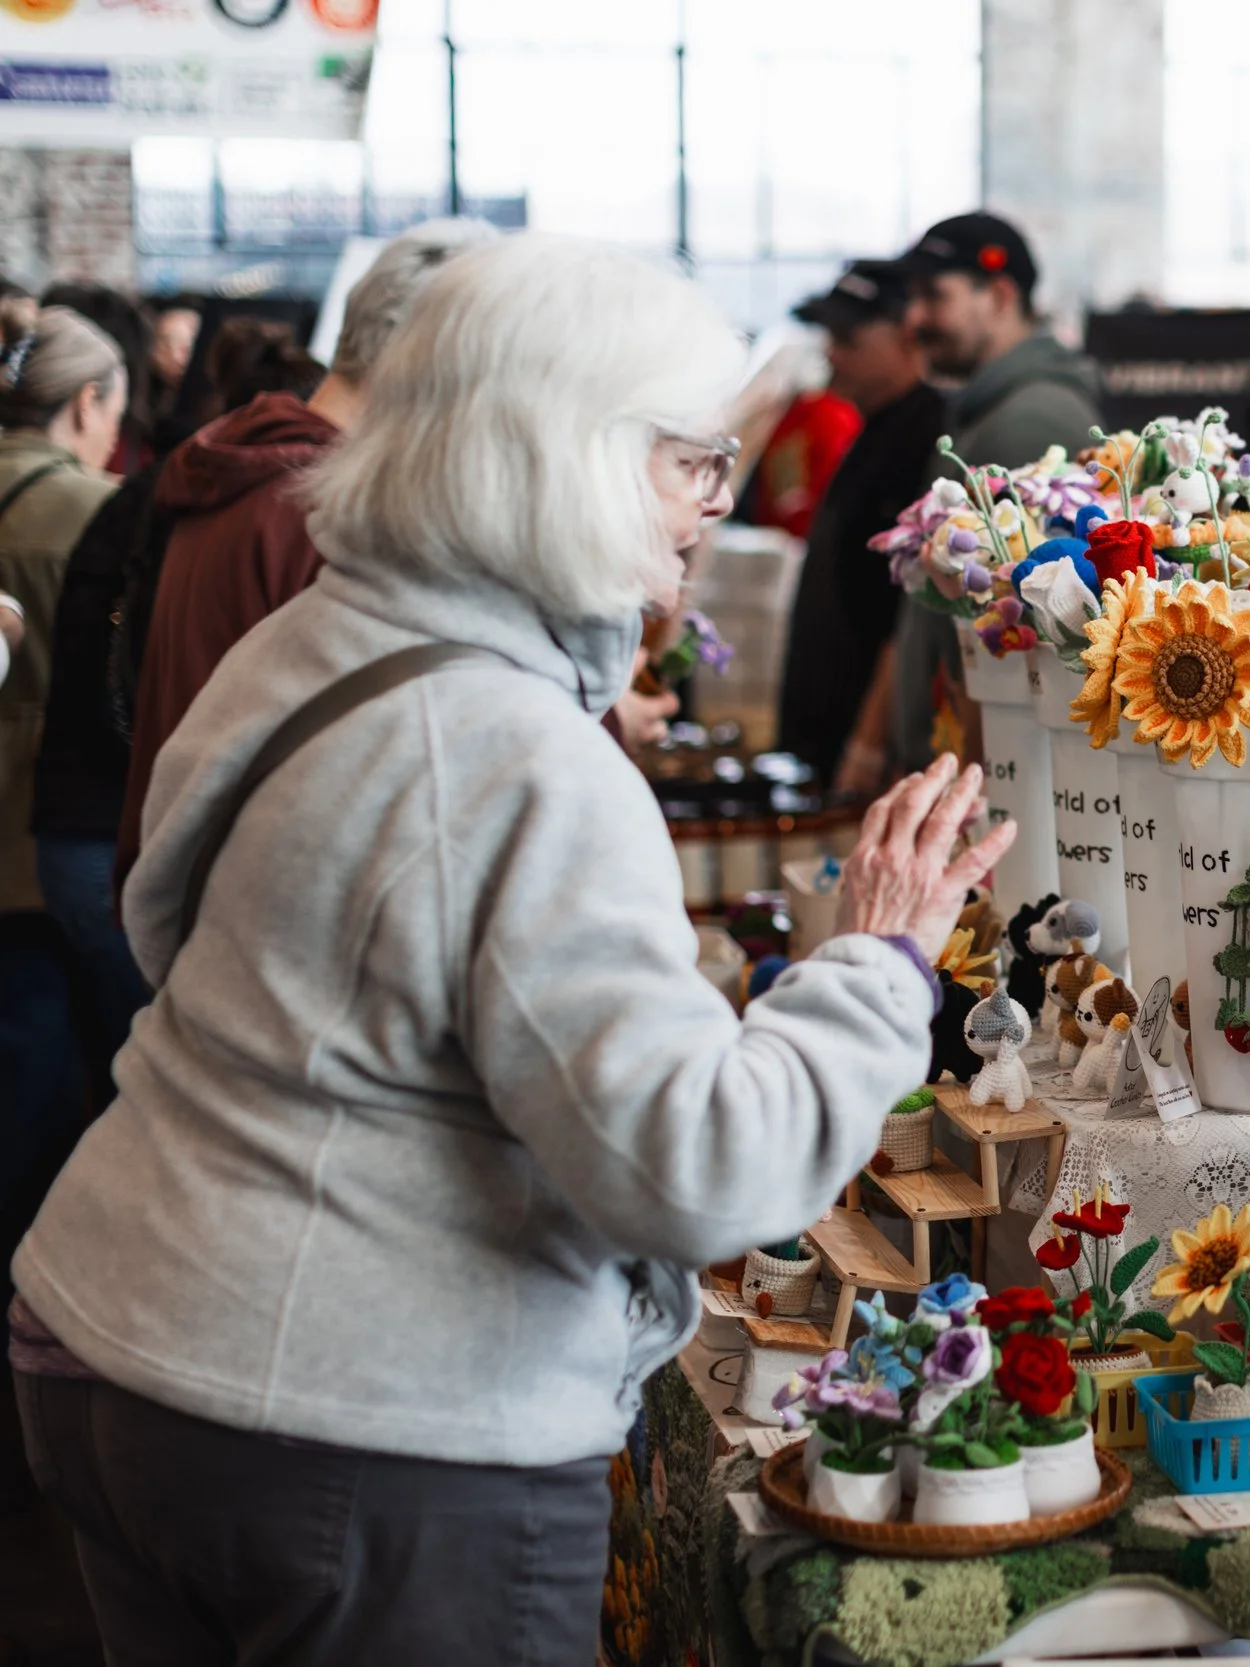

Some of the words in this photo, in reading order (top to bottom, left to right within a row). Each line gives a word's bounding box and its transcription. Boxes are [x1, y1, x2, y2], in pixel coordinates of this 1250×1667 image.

[995, 761, 1016, 782] of
[1132, 818, 1156, 840] of
[1178, 842, 1194, 871] ld
[1202, 850, 1231, 873] of
[1124, 871, 1149, 891] ers
